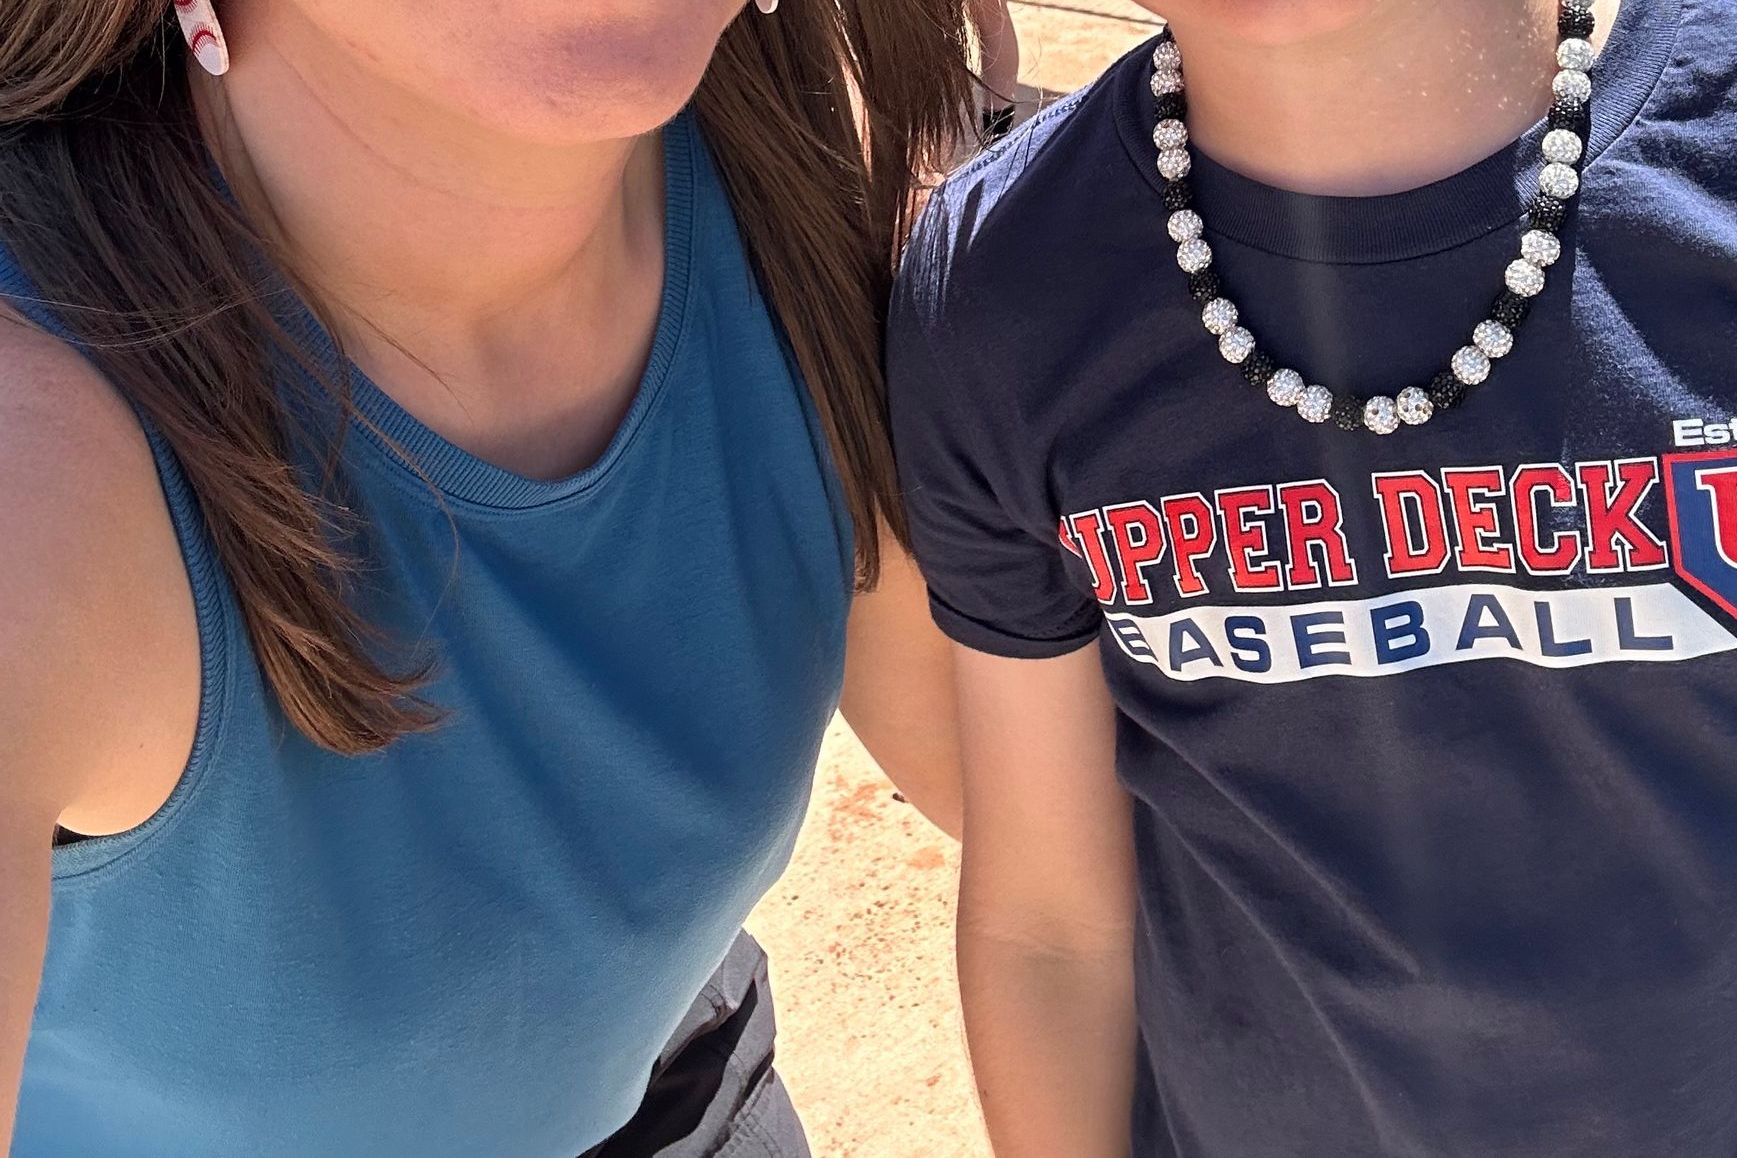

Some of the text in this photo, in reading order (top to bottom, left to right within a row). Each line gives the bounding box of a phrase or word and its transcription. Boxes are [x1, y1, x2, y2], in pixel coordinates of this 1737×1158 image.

[1058, 477, 1358, 606] UPPER
[1371, 457, 1669, 579] DECK
[1106, 593, 1675, 675] BASEBALL
